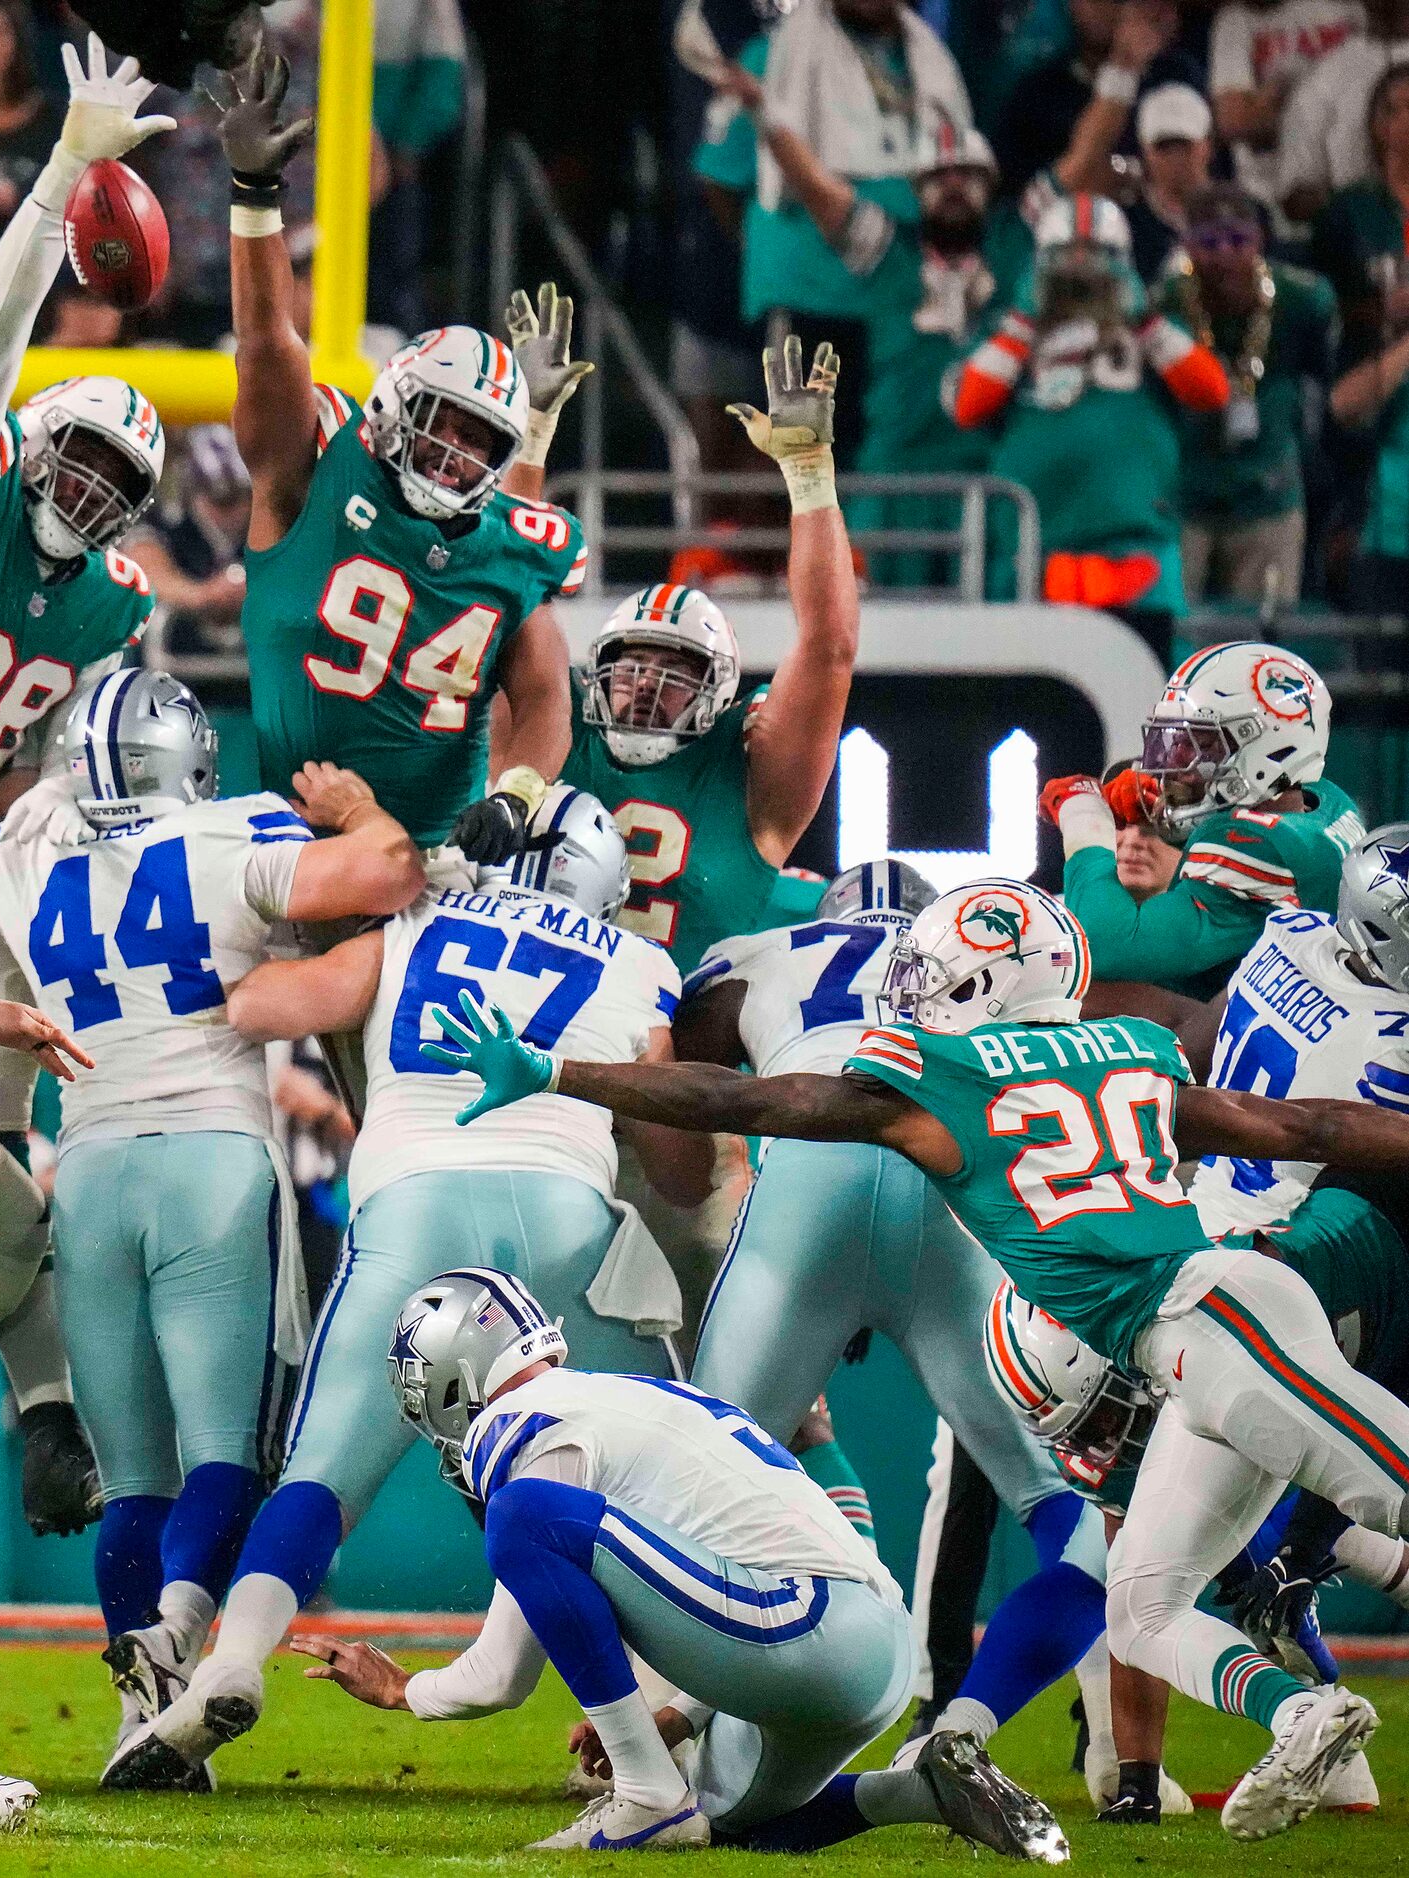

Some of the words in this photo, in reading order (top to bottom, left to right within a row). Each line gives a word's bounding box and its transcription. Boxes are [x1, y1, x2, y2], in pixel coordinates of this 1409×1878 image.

[344, 494, 377, 530] C
[303, 554, 502, 731] 94
[29, 835, 226, 1032] 44
[389, 915, 606, 1076] 67
[1243, 942, 1351, 1044] RICHARDS
[969, 1023, 1157, 1078] BETHEL
[985, 1066, 1192, 1232] 20
